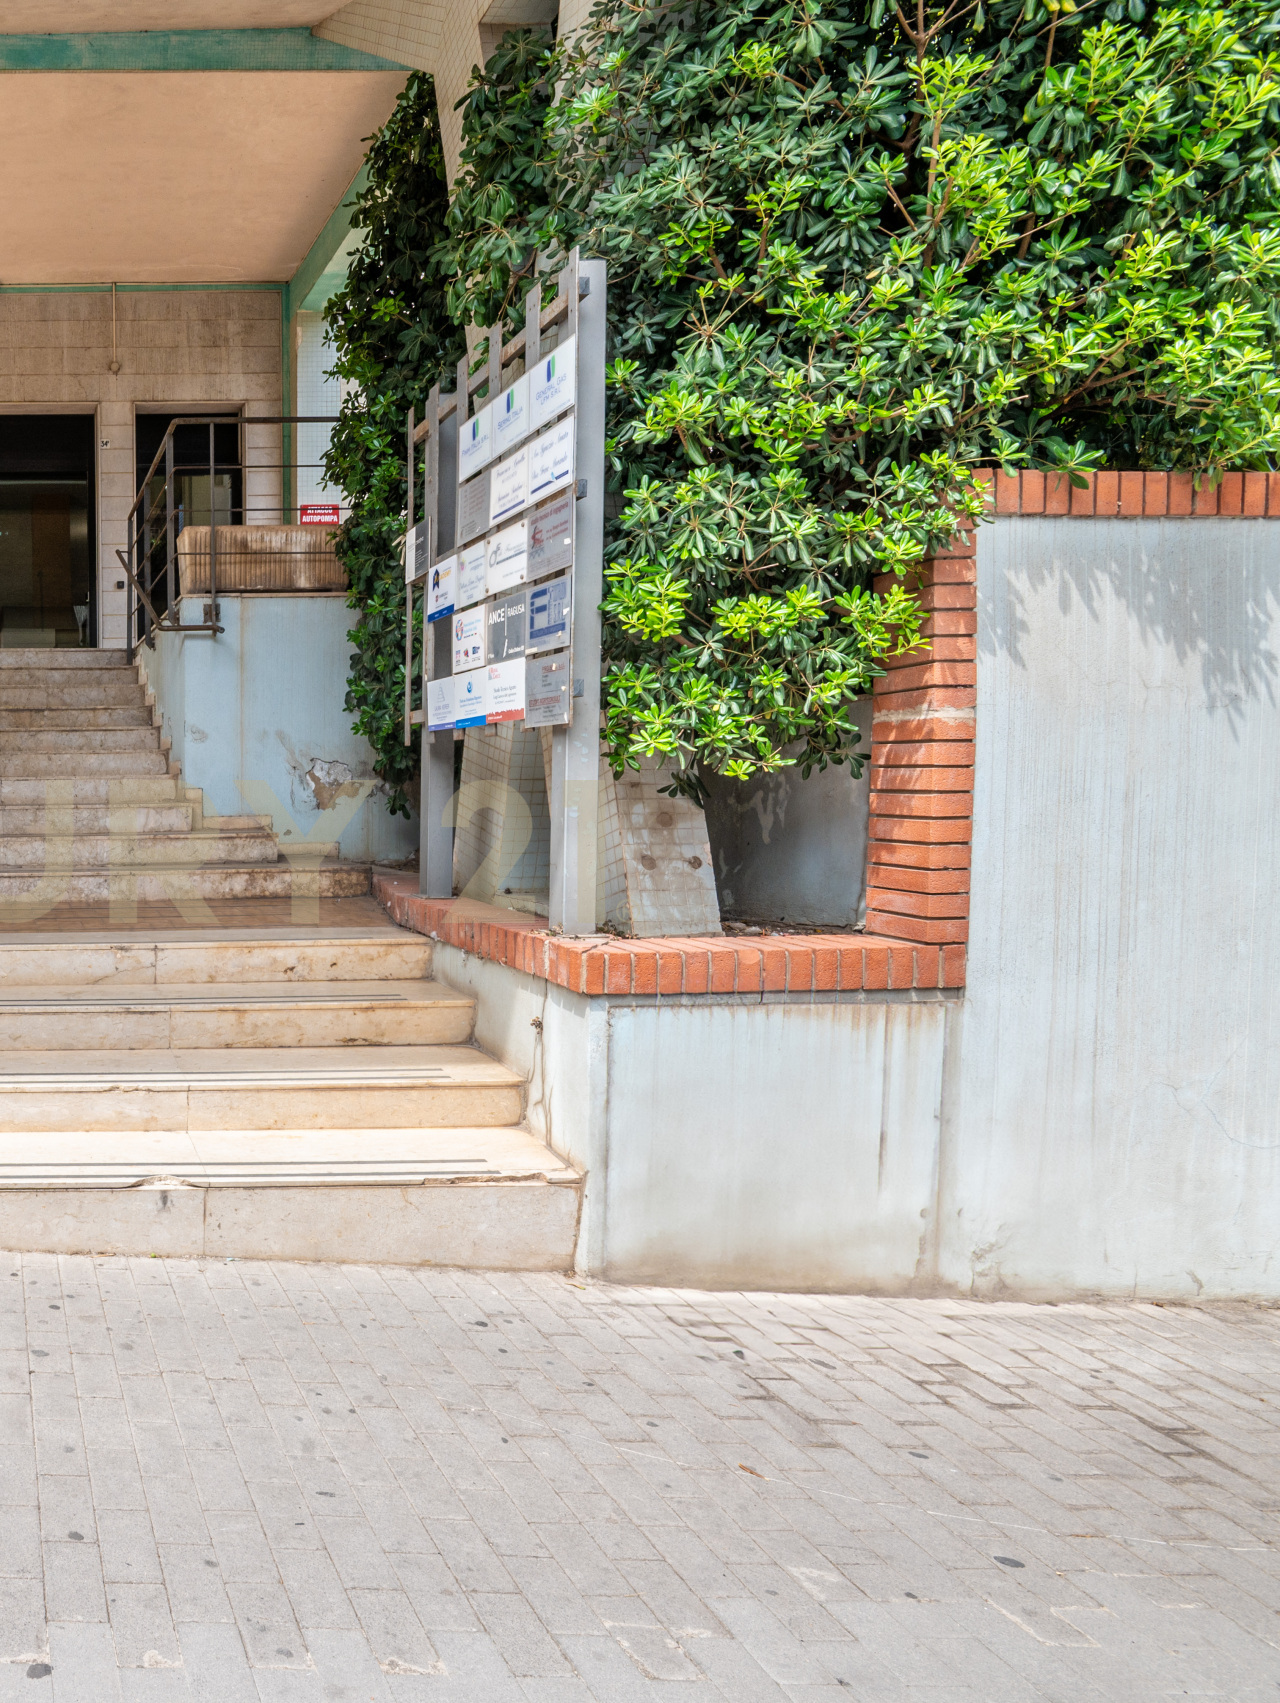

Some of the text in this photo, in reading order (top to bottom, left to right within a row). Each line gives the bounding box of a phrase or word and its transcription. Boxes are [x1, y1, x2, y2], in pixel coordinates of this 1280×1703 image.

[556, 373, 567, 386] GAS
[302, 515, 338, 523] AUTOPOMPA
[488, 604, 525, 625] ANCE RAGUSA
